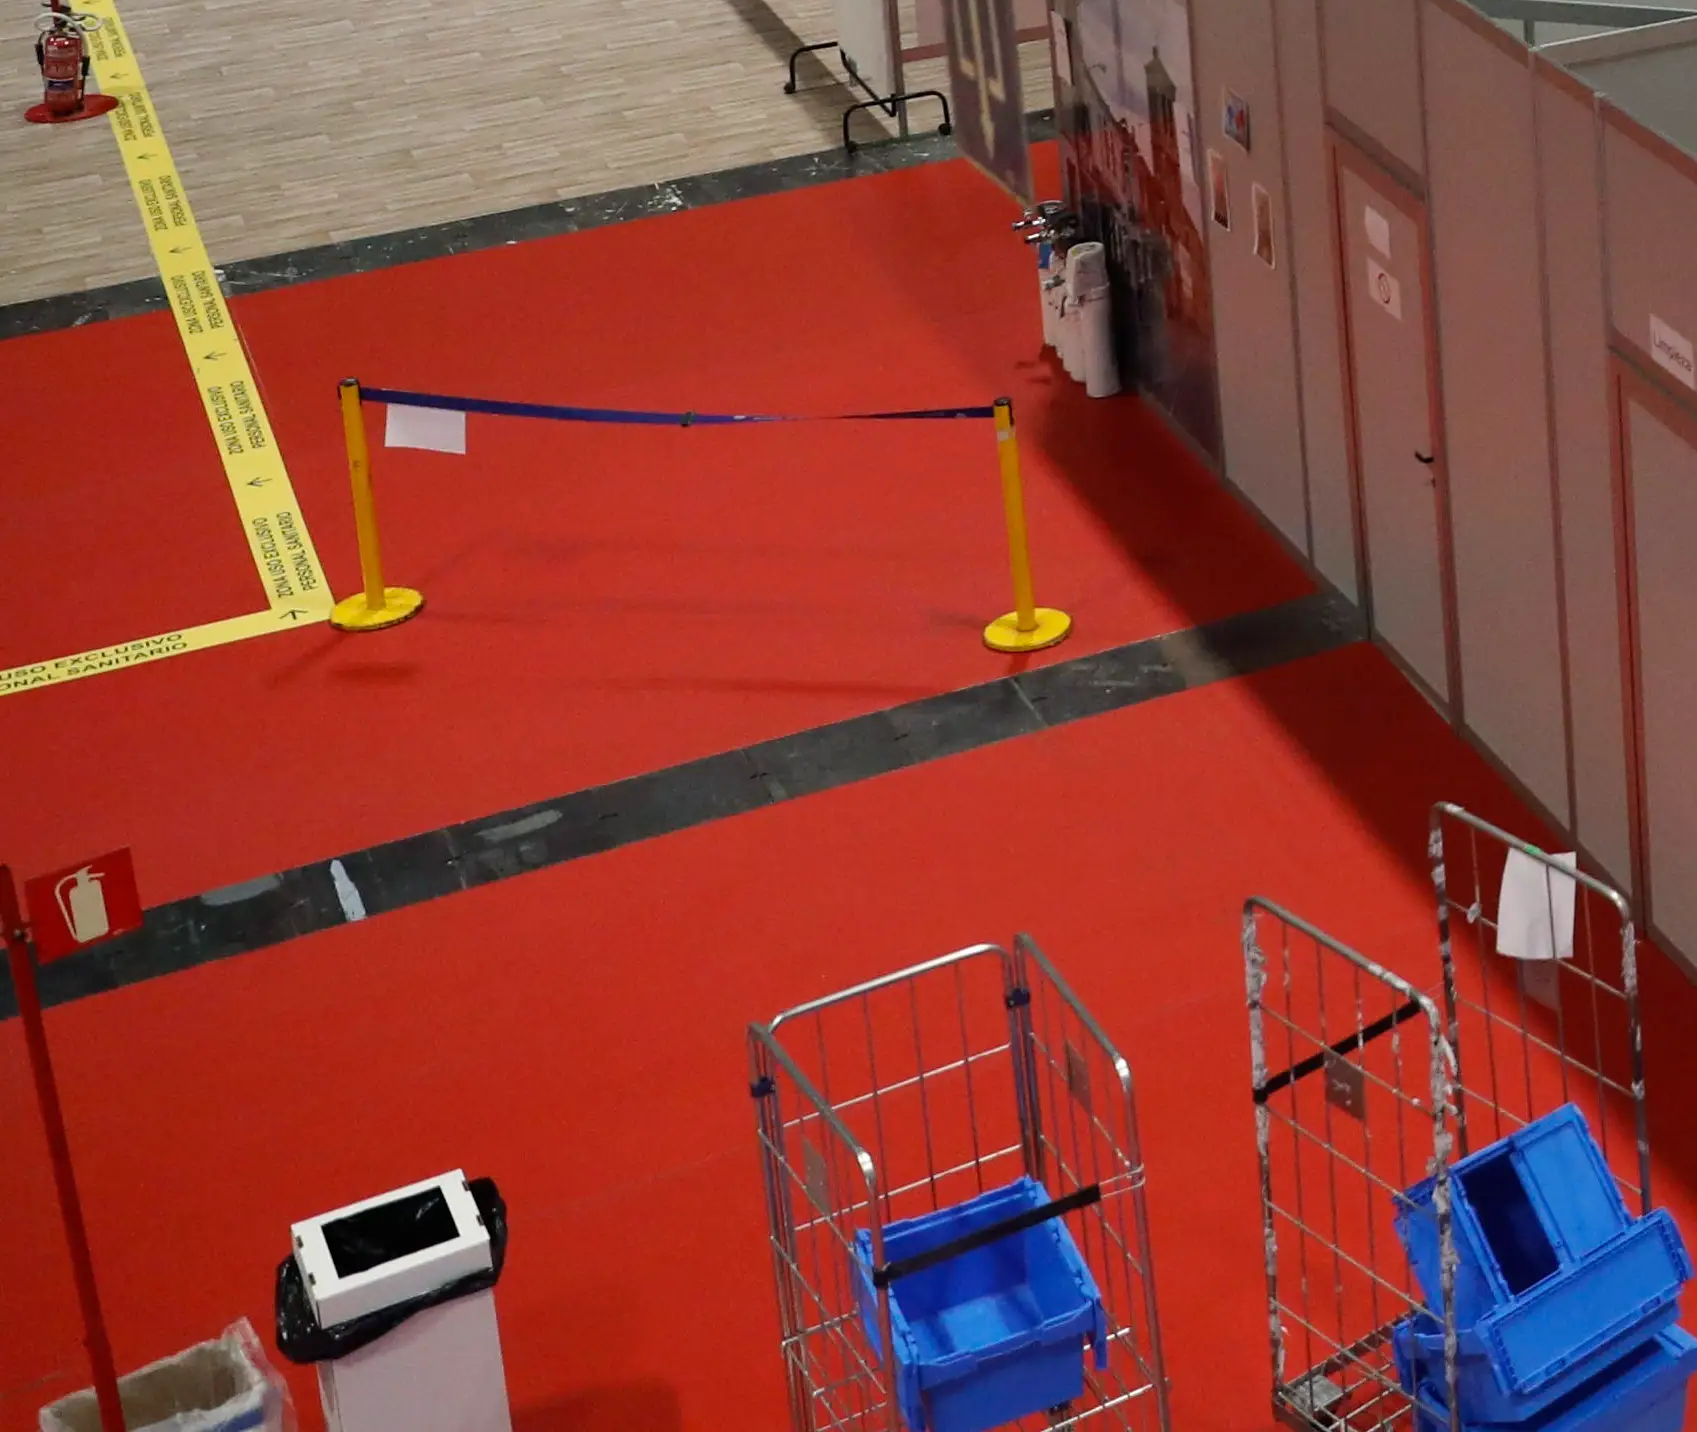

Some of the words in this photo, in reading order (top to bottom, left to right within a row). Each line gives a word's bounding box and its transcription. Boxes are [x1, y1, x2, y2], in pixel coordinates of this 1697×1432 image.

[207, 385, 232, 422] EXCLUSIVO
[230, 380, 254, 414] SANITARIO
[220, 421, 237, 436] USO
[224, 435, 244, 455] ZONA
[243, 413, 267, 448] PERSONAL
[252, 517, 280, 559] EXCLUSIVO
[276, 511, 304, 551] SANITARIO
[265, 559, 285, 576] USO
[291, 549, 319, 591] PERSONAL
[272, 575, 294, 598] ZONA
[55, 634, 182, 669] EXCLUSIVO
[68, 642, 187, 677] SANITARIO
